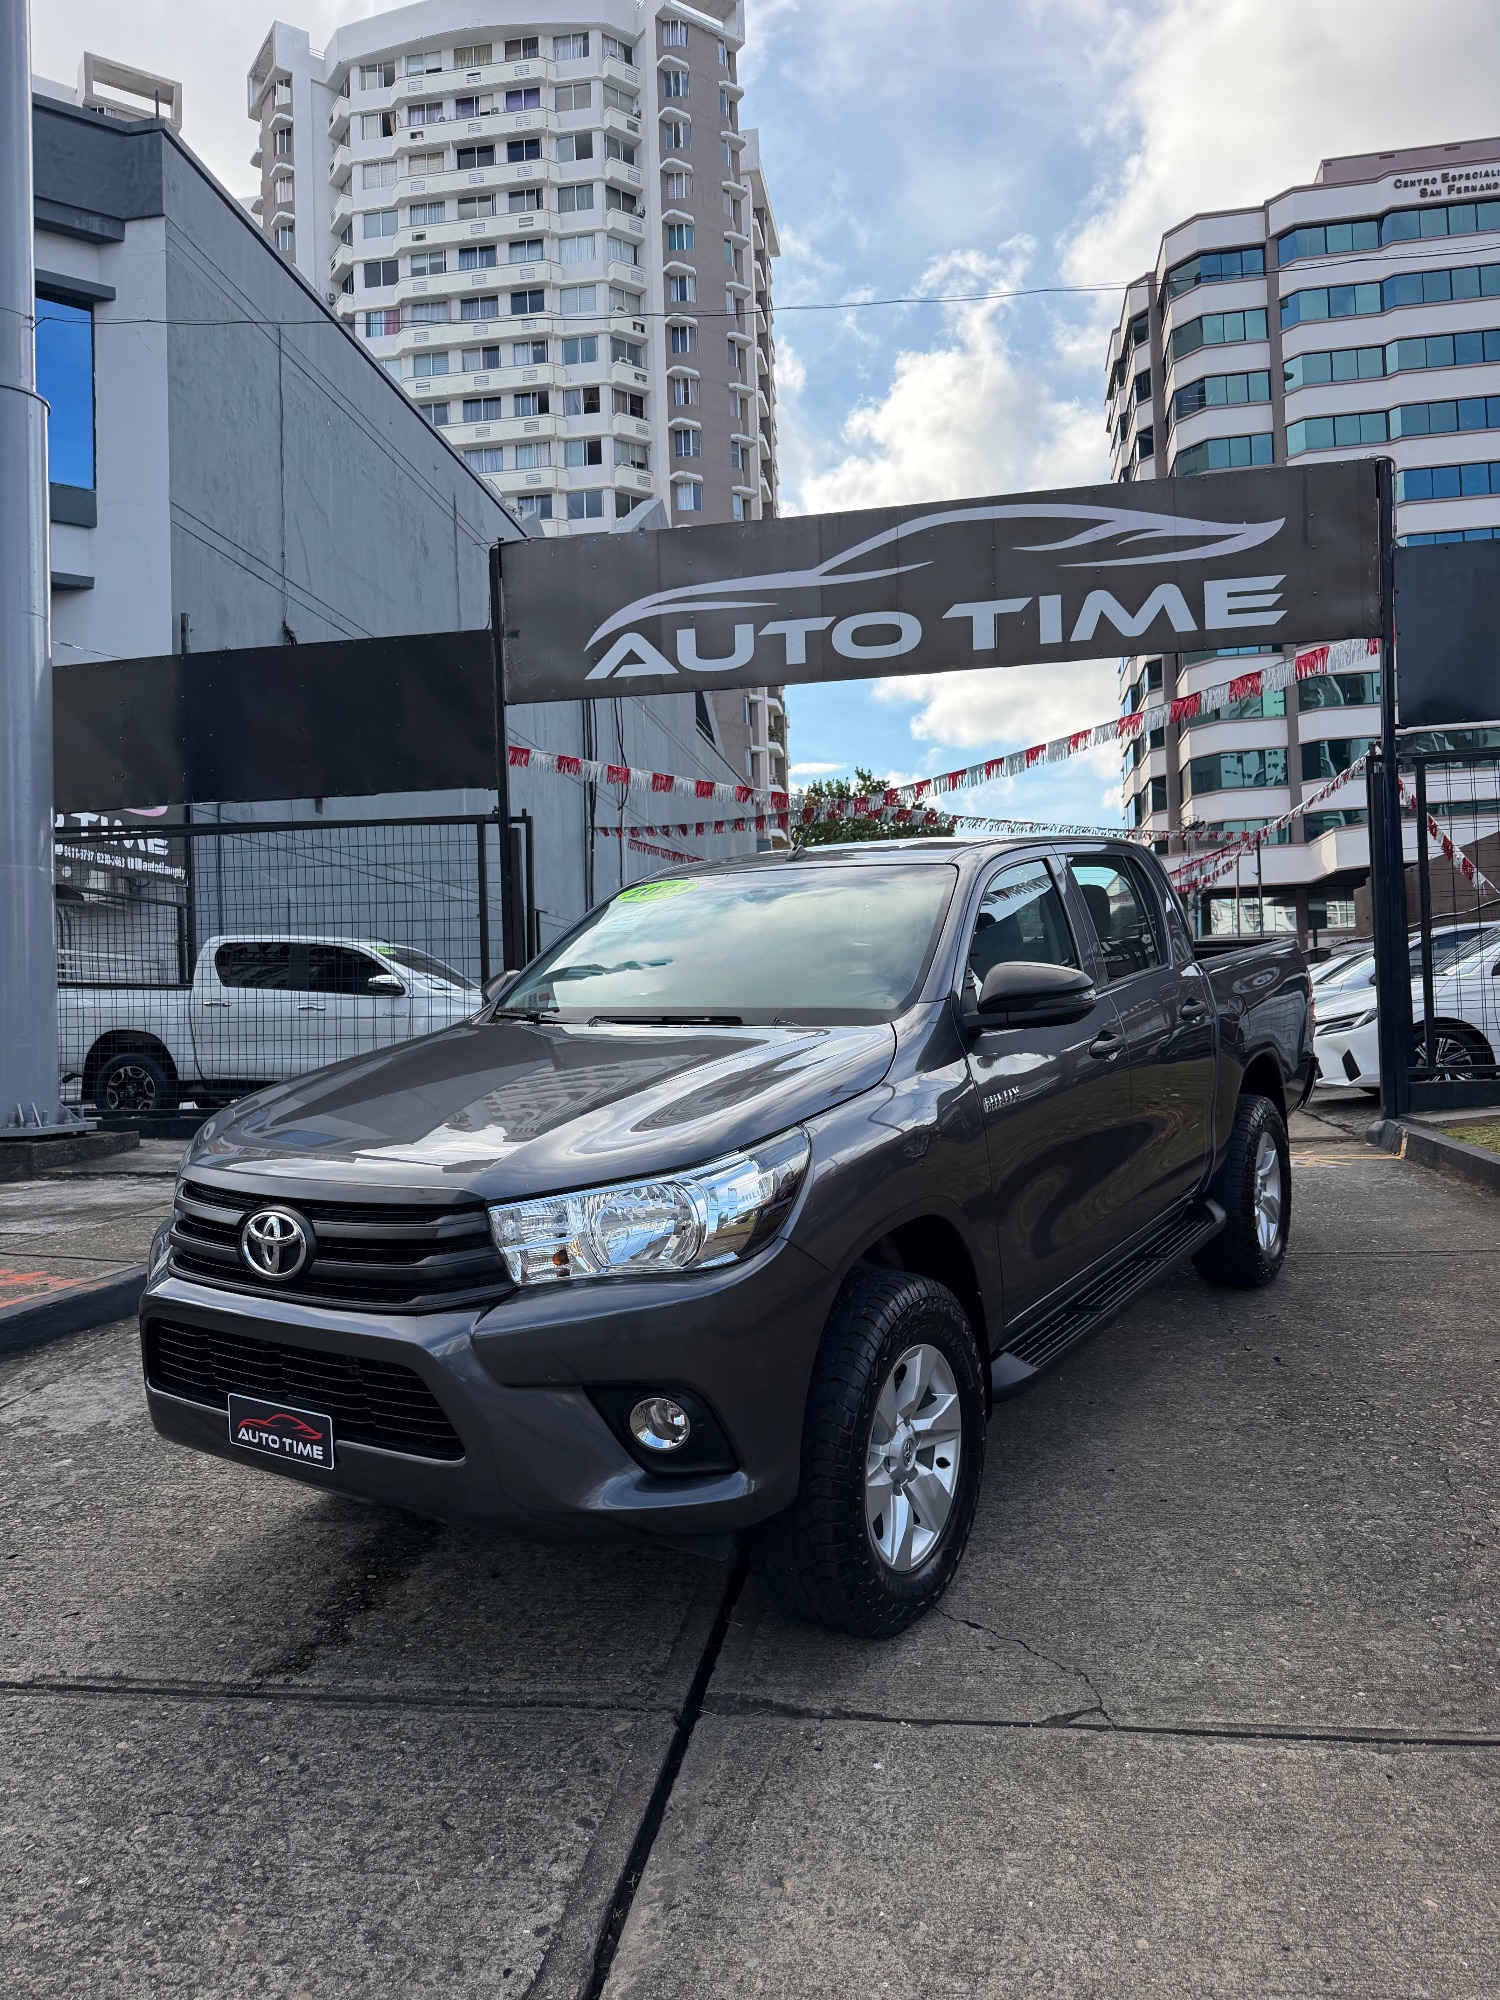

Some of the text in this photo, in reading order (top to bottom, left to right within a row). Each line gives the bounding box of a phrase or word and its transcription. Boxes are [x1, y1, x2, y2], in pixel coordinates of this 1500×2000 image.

[1394, 177, 1437, 189] CENTRO
[1419, 187, 1441, 198] SAN
[584, 574, 1288, 680] AUTO TIME
[237, 1427, 324, 1460] AUTO TIME
